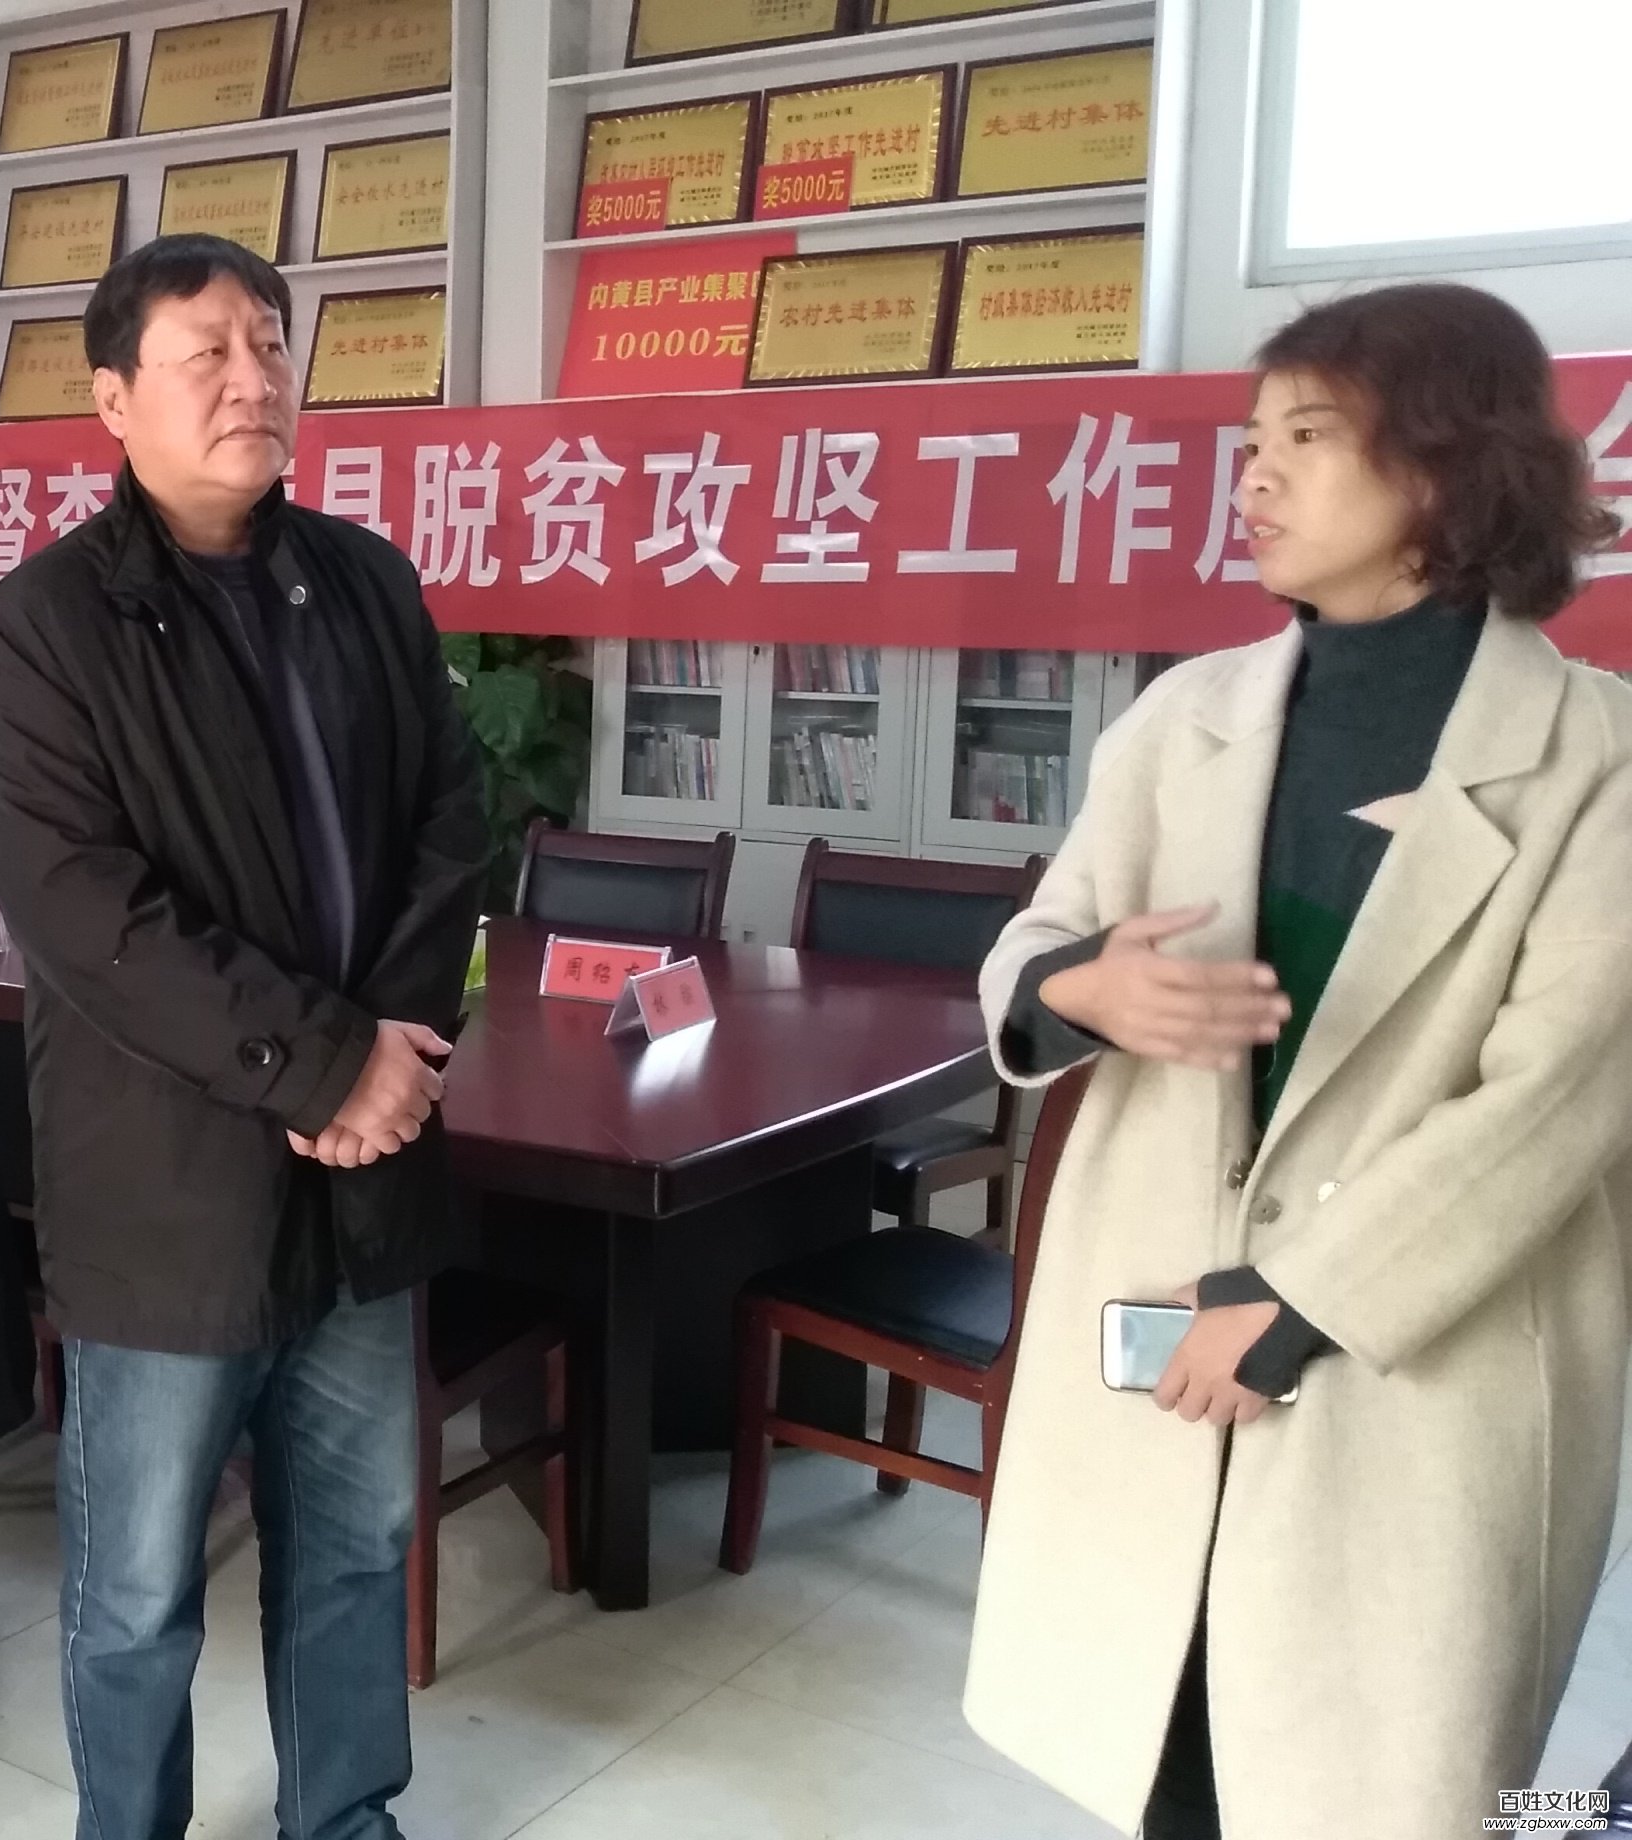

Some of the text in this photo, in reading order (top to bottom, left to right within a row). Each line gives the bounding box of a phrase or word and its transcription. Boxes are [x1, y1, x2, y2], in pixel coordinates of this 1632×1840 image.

[981, 101, 1144, 137] 先进村集体
[762, 169, 845, 209] 奖5000元
[586, 190, 662, 227] 奖5000元
[779, 296, 916, 328] 农村先进集体
[330, 333, 428, 356] 先进村集体
[591, 324, 750, 362] 10000元
